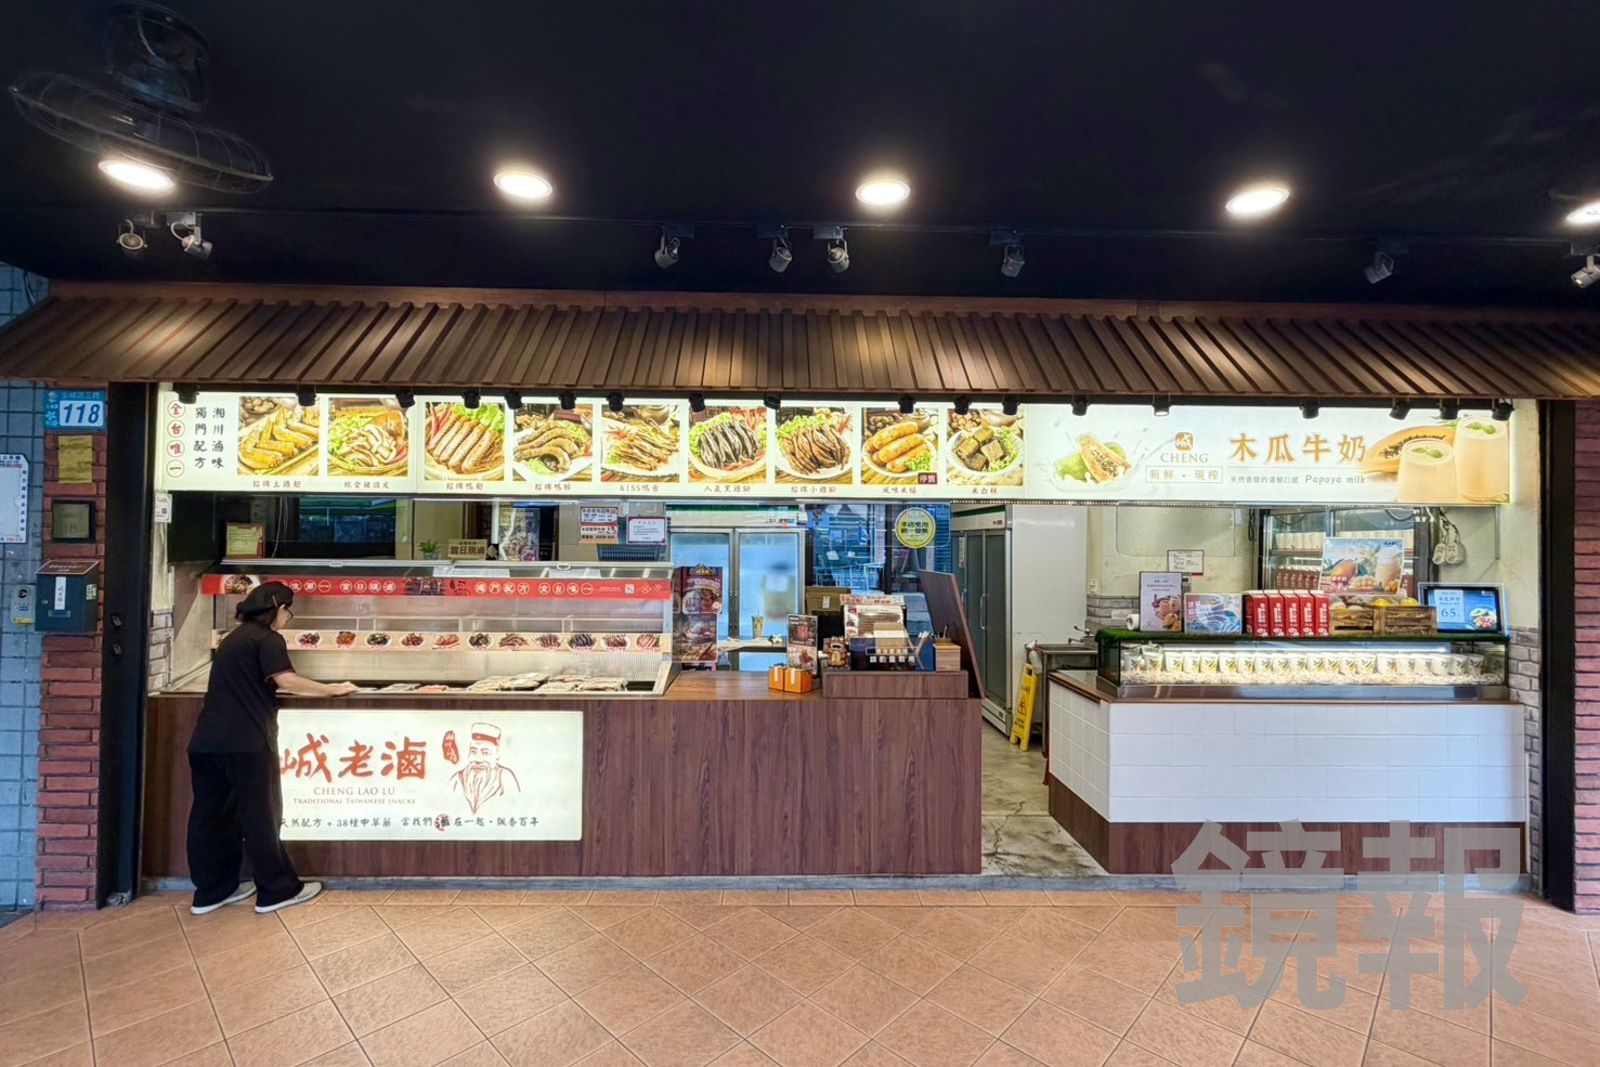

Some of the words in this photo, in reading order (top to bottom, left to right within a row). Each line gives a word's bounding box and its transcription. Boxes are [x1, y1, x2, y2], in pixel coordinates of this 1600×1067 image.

[63, 403, 101, 424] 118
[167, 400, 185, 478] 全台唯一
[193, 406, 208, 469] 獨門配方
[1229, 432, 1367, 464] 木瓜牛奶
[1160, 453, 1209, 464] CHENG
[1304, 474, 1342, 486] Papaya
[1346, 474, 1367, 484] milk
[313, 786, 354, 796] CHENG
[357, 786, 380, 796] LAO
[382, 786, 396, 796] LU
